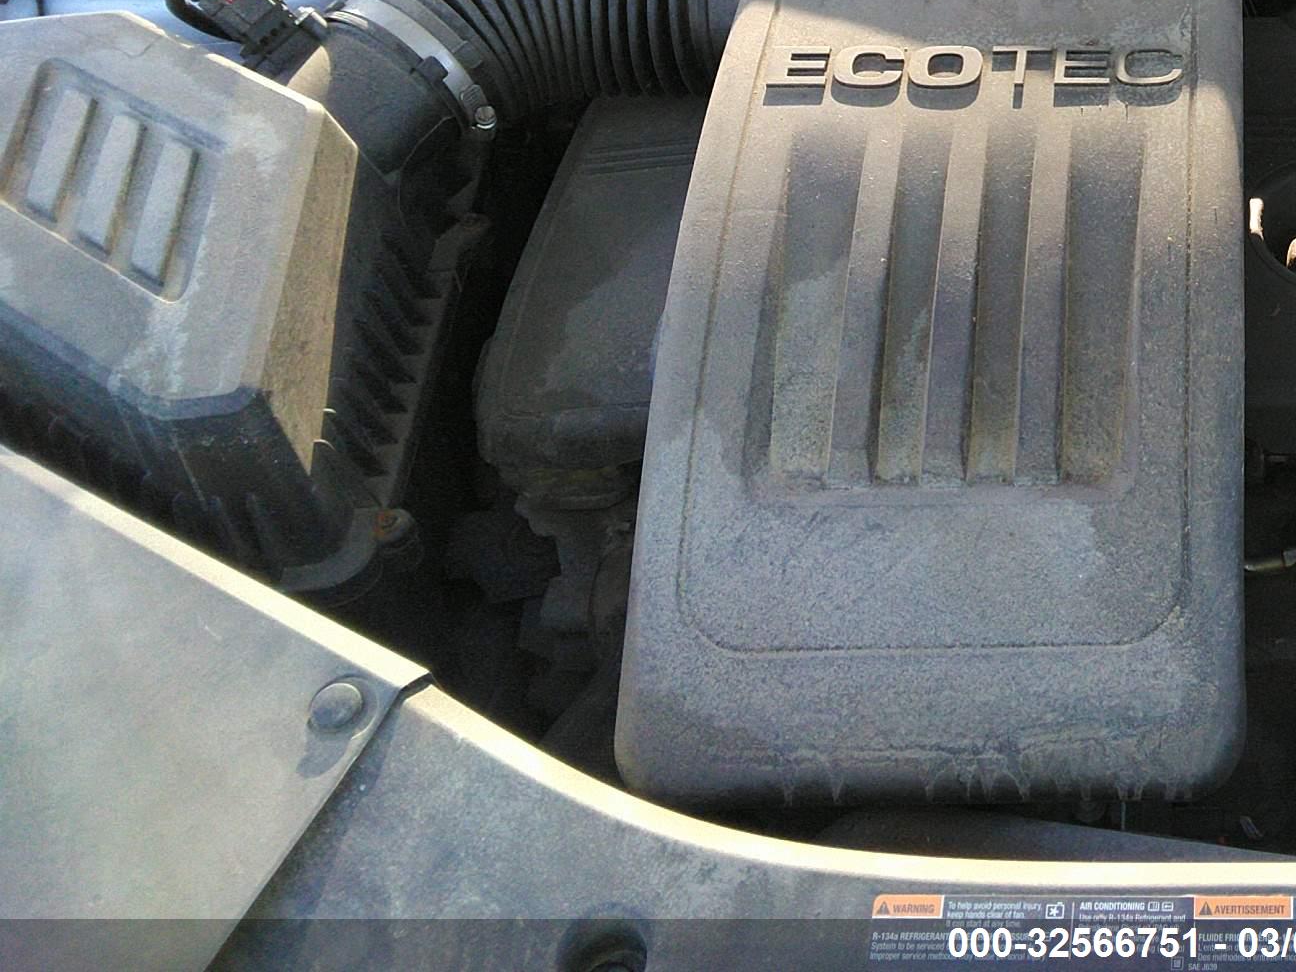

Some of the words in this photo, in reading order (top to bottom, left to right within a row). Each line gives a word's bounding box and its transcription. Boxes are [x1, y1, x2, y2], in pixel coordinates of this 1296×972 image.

[765, 43, 1185, 94] ECOTEC
[893, 904, 935, 914] WARNING
[948, 901, 956, 910] To
[957, 901, 972, 911] help
[973, 901, 992, 910] avoid
[993, 901, 1022, 912] personal
[1079, 901, 1092, 910] AIR
[1093, 901, 1145, 911] CONDITIONING
[1214, 905, 1284, 915] AVERTISSEMENT
[947, 911, 964, 920] keep
[964, 911, 986, 919] hands
[986, 911, 1004, 919] clear
[1004, 911, 1012, 919] of
[1079, 914, 1092, 922] Use
[872, 932, 898, 941] R-134a
[899, 932, 950, 941] REFRIGERANT
[1198, 933, 1223, 942] FLUIDE
[871, 942, 896, 952] System
[897, 942, 904, 950] to
[905, 942, 915, 950] be
[916, 942, 945, 951] serviced
[869, 952, 900, 962] Improper
[901, 952, 926, 960] service
[1188, 963, 1200, 971] SAE
